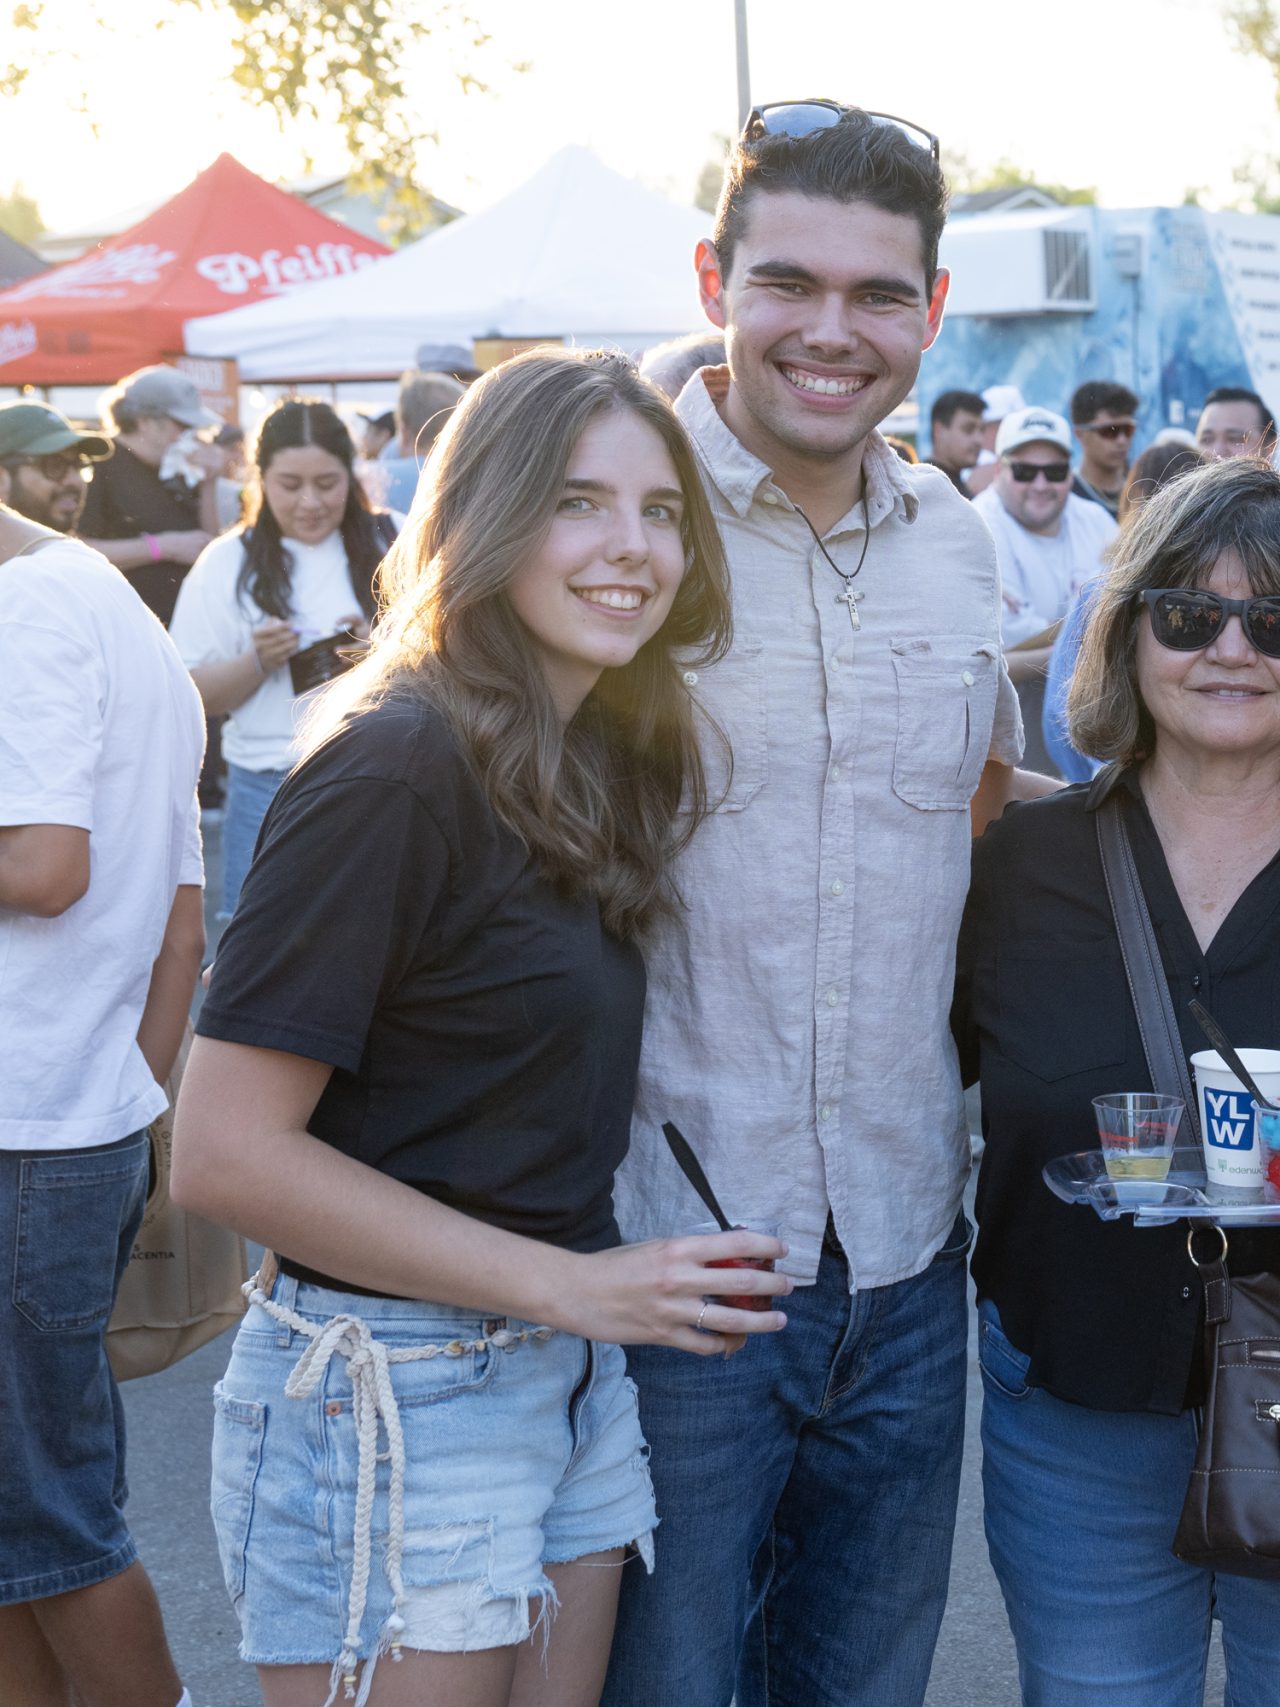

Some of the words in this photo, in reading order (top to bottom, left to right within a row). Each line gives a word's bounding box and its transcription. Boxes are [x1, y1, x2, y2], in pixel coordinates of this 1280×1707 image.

[196, 242, 392, 294] Pfeiffe
[1207, 1091, 1250, 1120] YL
[1211, 1118, 1246, 1146] W
